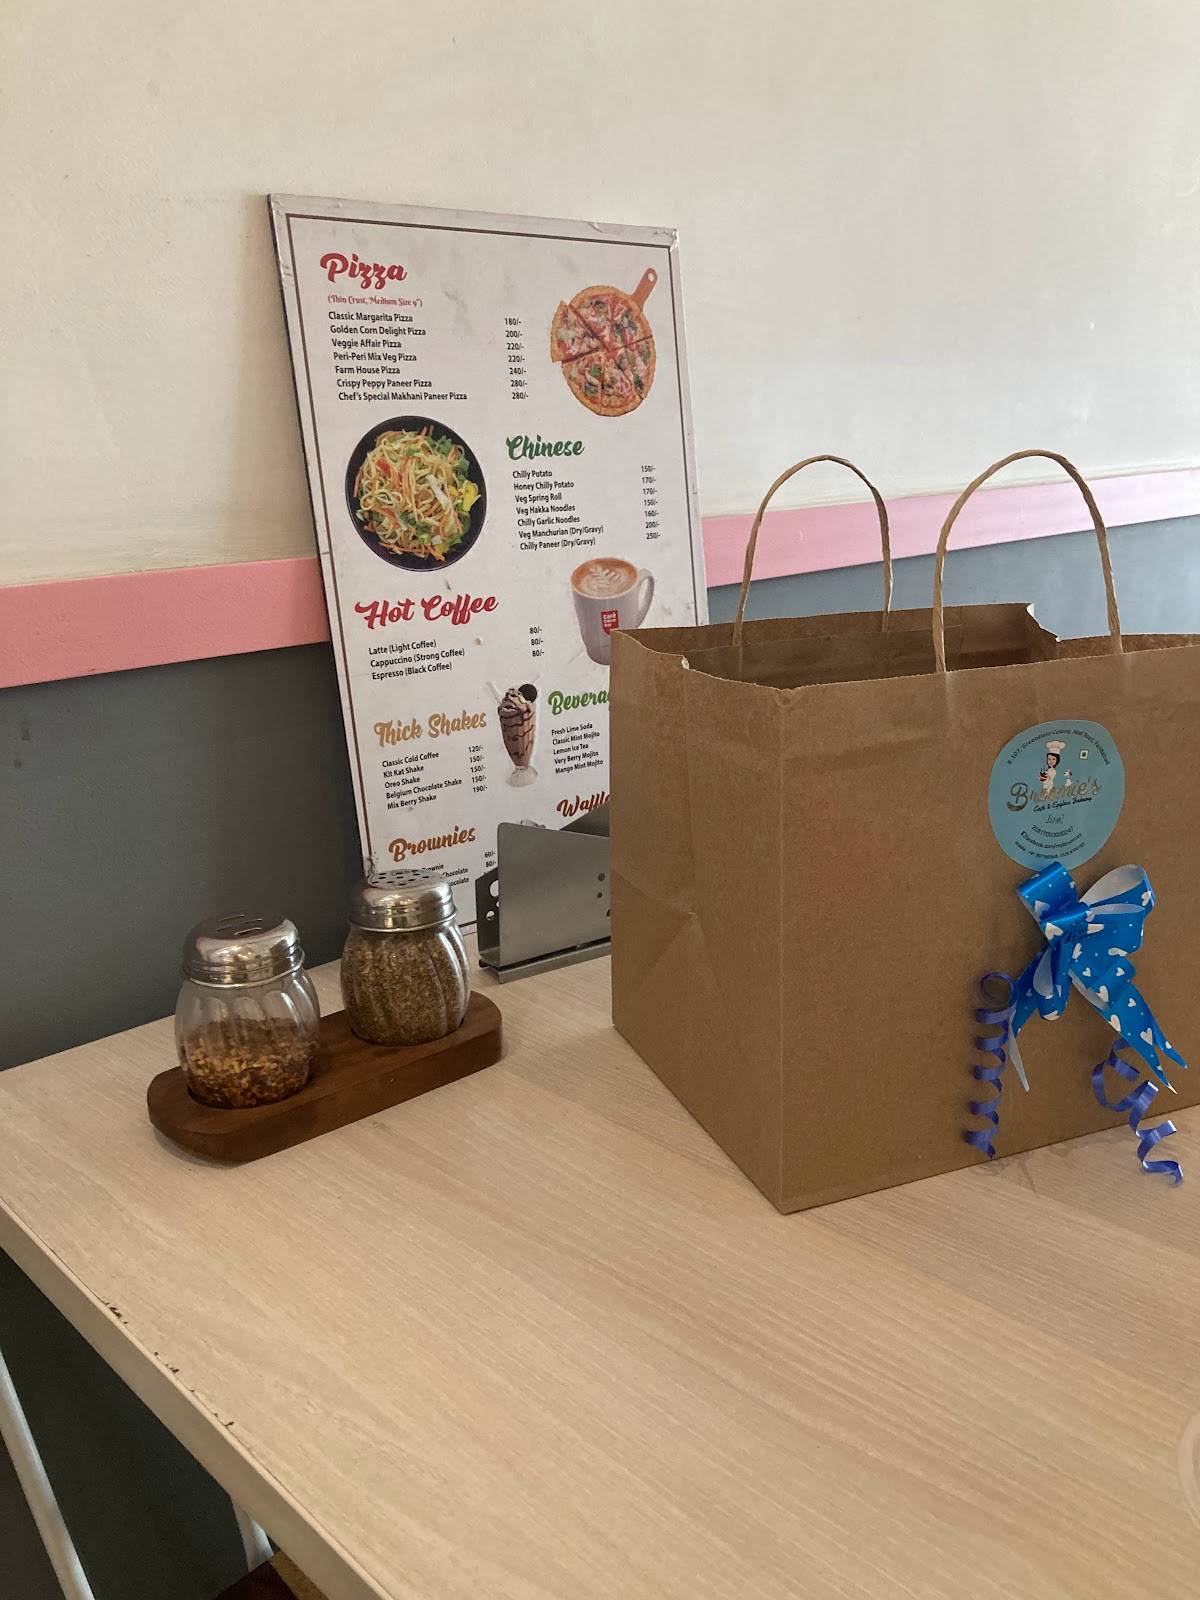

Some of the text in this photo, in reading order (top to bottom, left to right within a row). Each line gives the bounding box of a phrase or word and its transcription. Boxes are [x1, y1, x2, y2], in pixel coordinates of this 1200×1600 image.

[320, 253, 407, 290] Pizza
[329, 312, 413, 323] Classic Margarita Pizza
[505, 318, 521, 326] 180/-
[330, 325, 358, 334] Golden
[360, 326, 378, 334] Corn
[379, 327, 406, 337] Delight
[506, 330, 523, 338] 200/-
[332, 339, 401, 349] Veggie Affair Pizza
[334, 353, 366, 361] Peri-Peri
[368, 353, 381, 361] Mix
[383, 353, 397, 362] Veg
[508, 355, 525, 363] 220/-
[335, 366, 400, 374] Farm House Pizza
[337, 379, 361, 388] Crispy
[362, 380, 386, 389] Peppy
[414, 379, 432, 387] Pizza
[339, 392, 467, 402] Chef's Special Makhani Paneer Pizza
[512, 392, 528, 400] 280/-
[506, 434, 584, 460] Chinese
[513, 471, 531, 479] Chilly
[514, 483, 534, 491] Honey
[535, 482, 553, 490] Chilly
[515, 495, 527, 503] Veg
[529, 494, 549, 502] Spring
[516, 507, 528, 515] Veg
[530, 506, 549, 514] Hakka
[519, 525, 603, 539] Veg Manchurian (Dry/Gravy)
[520, 538, 595, 551] Chilly Paneer (Dry/Gravy)
[355, 594, 498, 629] Hot Coffee
[369, 640, 436, 655] Latte (Light Coffee)
[370, 648, 464, 668] Cappuccino (Strong Coffee)
[372, 662, 452, 680] Espresso (Black Coffee)
[548, 690, 609, 715] Bevera
[374, 710, 487, 747] Thick Shakes
[552, 728, 565, 736] Fresh
[553, 737, 569, 745] Classic
[468, 745, 483, 753] 120/-
[382, 752, 439, 768] Classic Cold Coffee
[469, 755, 484, 763] 150/-
[405, 764, 424, 774] Shake
[470, 765, 485, 773] 150/-
[385, 776, 420, 788] Oreo Shake
[472, 775, 486, 783] 150/-
[386, 778, 462, 800] Belgium Chocolate Shake
[473, 785, 488, 793] 190/-
[401, 798, 417, 808] Berry
[418, 794, 437, 803] Shake
[388, 826, 475, 862] Brownies
[486, 860, 496, 868] 80/-
